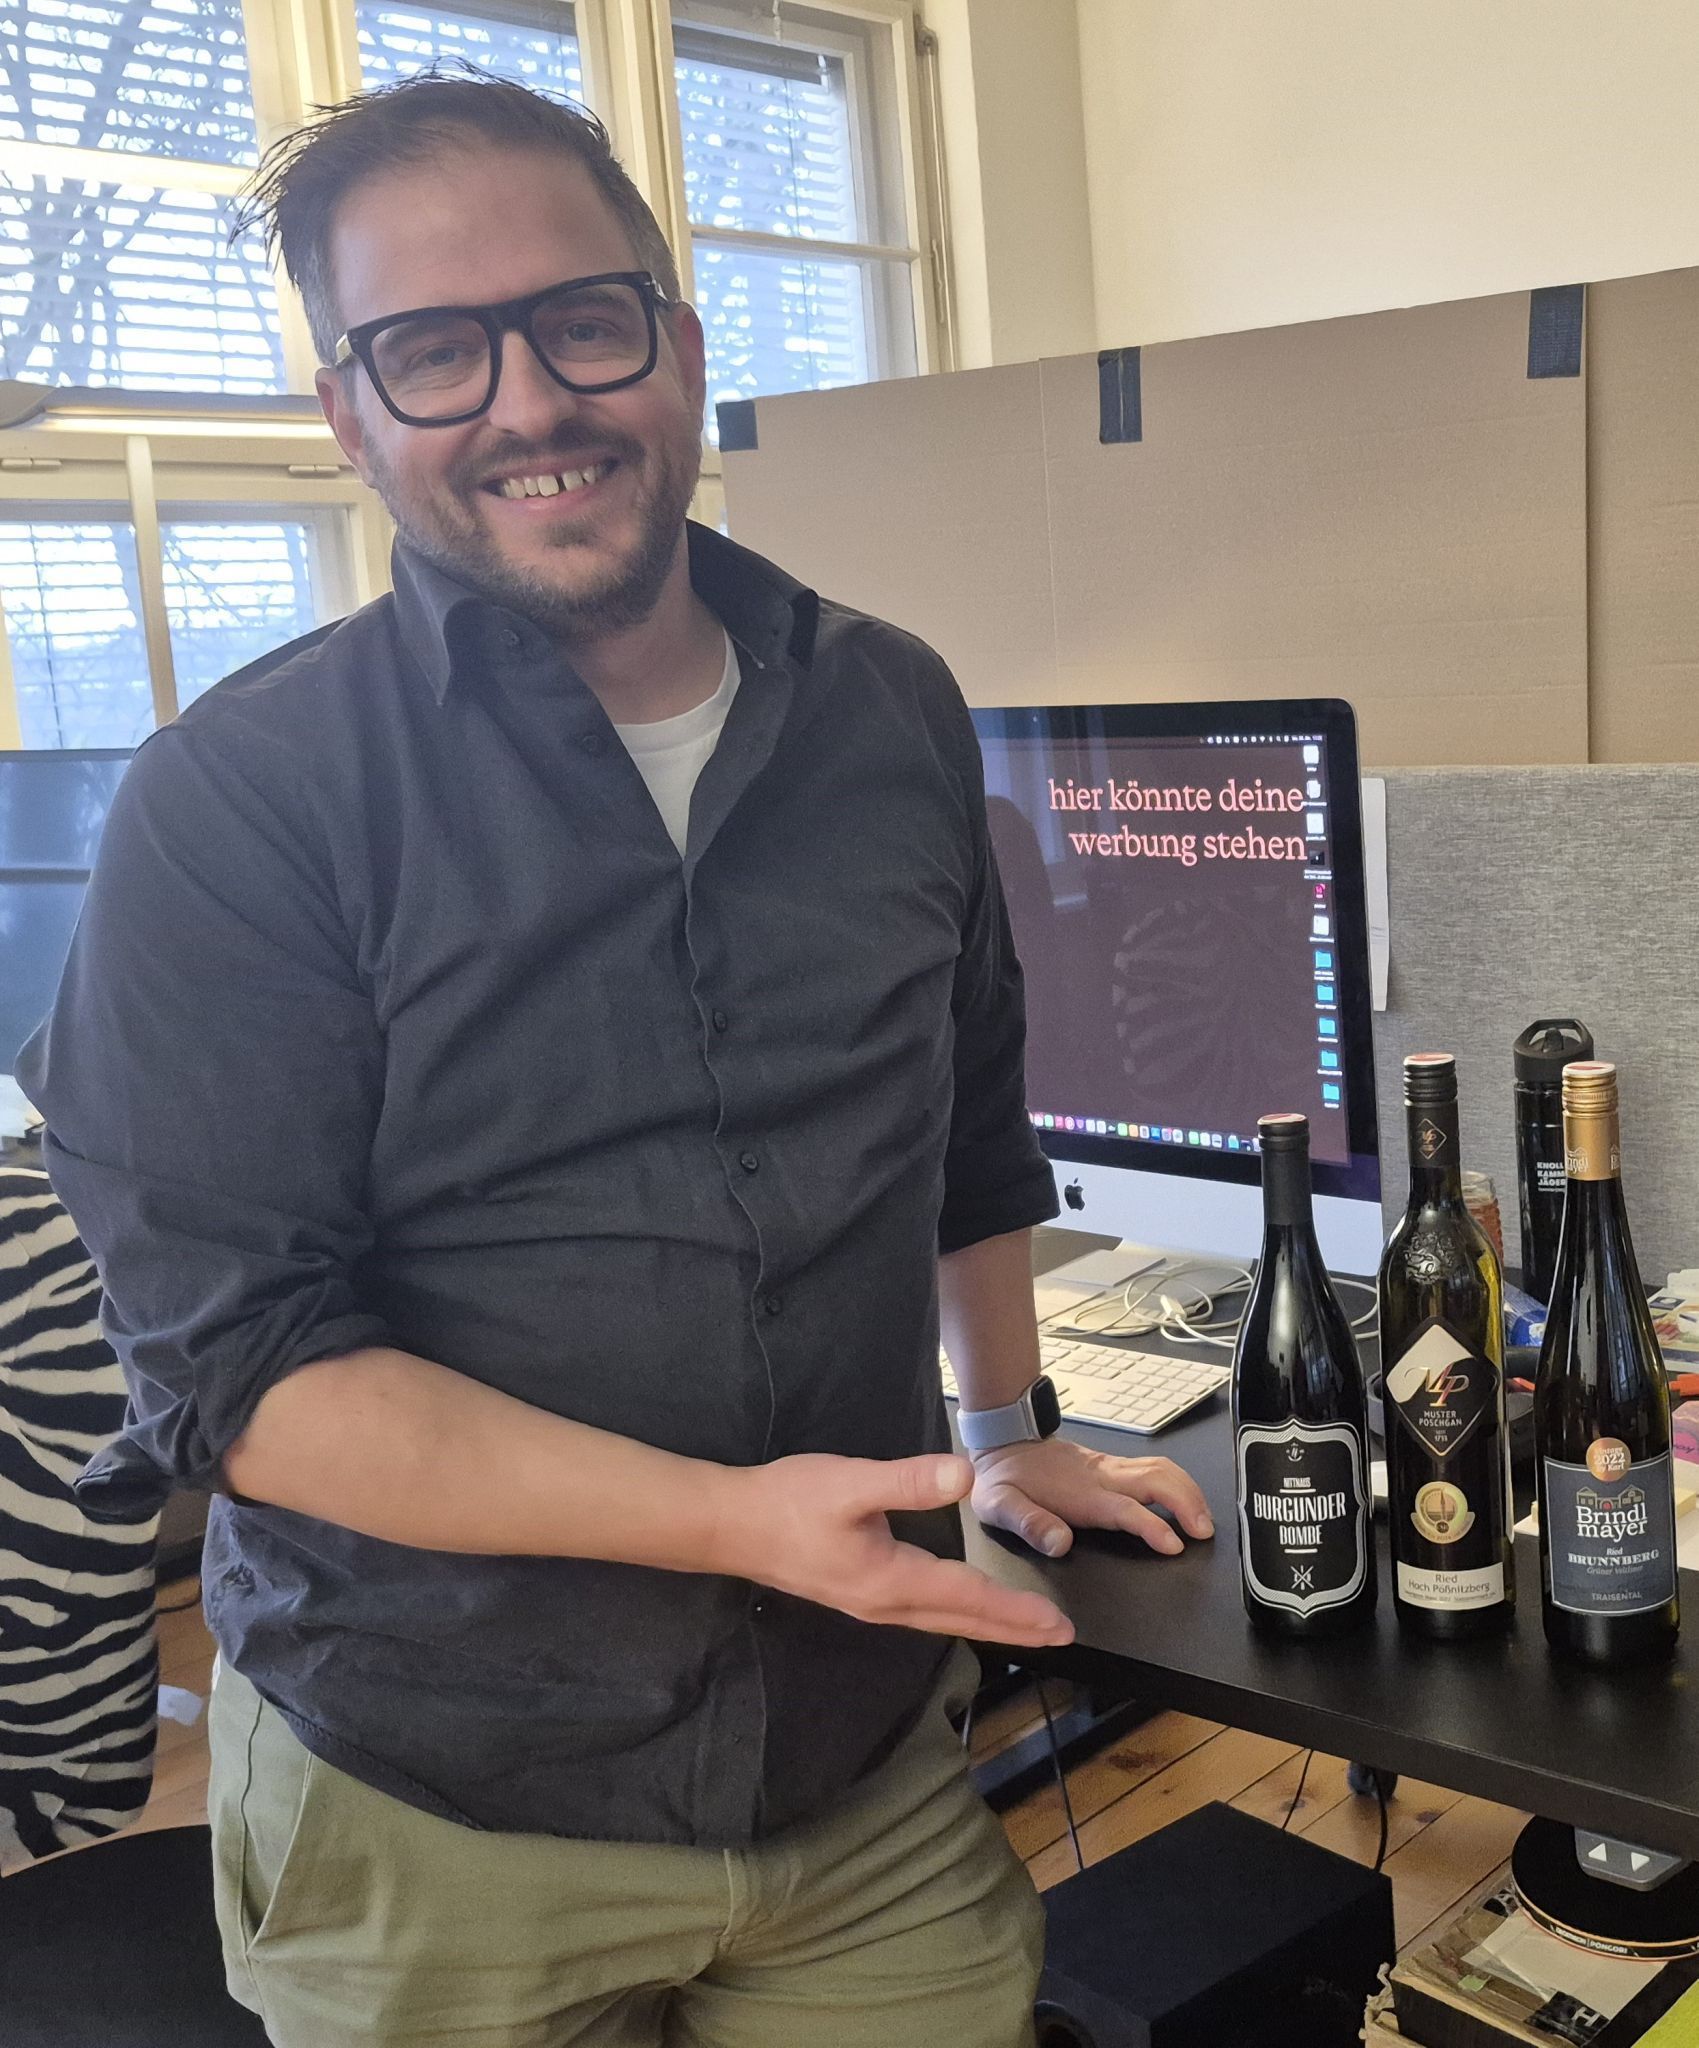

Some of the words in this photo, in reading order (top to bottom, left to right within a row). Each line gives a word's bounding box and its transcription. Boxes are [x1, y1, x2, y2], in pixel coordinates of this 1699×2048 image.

[1048, 778, 1104, 811] hier
[1108, 778, 1212, 812] könnte
[1218, 778, 1304, 813] deine
[1068, 824, 1198, 867] werbung
[1203, 826, 1308, 861] stehen
[1536, 1161, 1564, 1169] KNOLL
[1418, 1418, 1463, 1427] POSCHGAN
[1423, 1410, 1457, 1418] MUSTER
[1594, 1452, 1626, 1465] 2022
[1253, 1491, 1347, 1523] BURGUNDER
[1575, 1502, 1648, 1525] Brindl
[1279, 1524, 1324, 1546] BOMBE
[1576, 1520, 1648, 1543] mayer
[1567, 1548, 1660, 1566] BRUNNBERG
[1606, 1546, 1624, 1556] Ried
[1435, 1574, 1458, 1583] Ried
